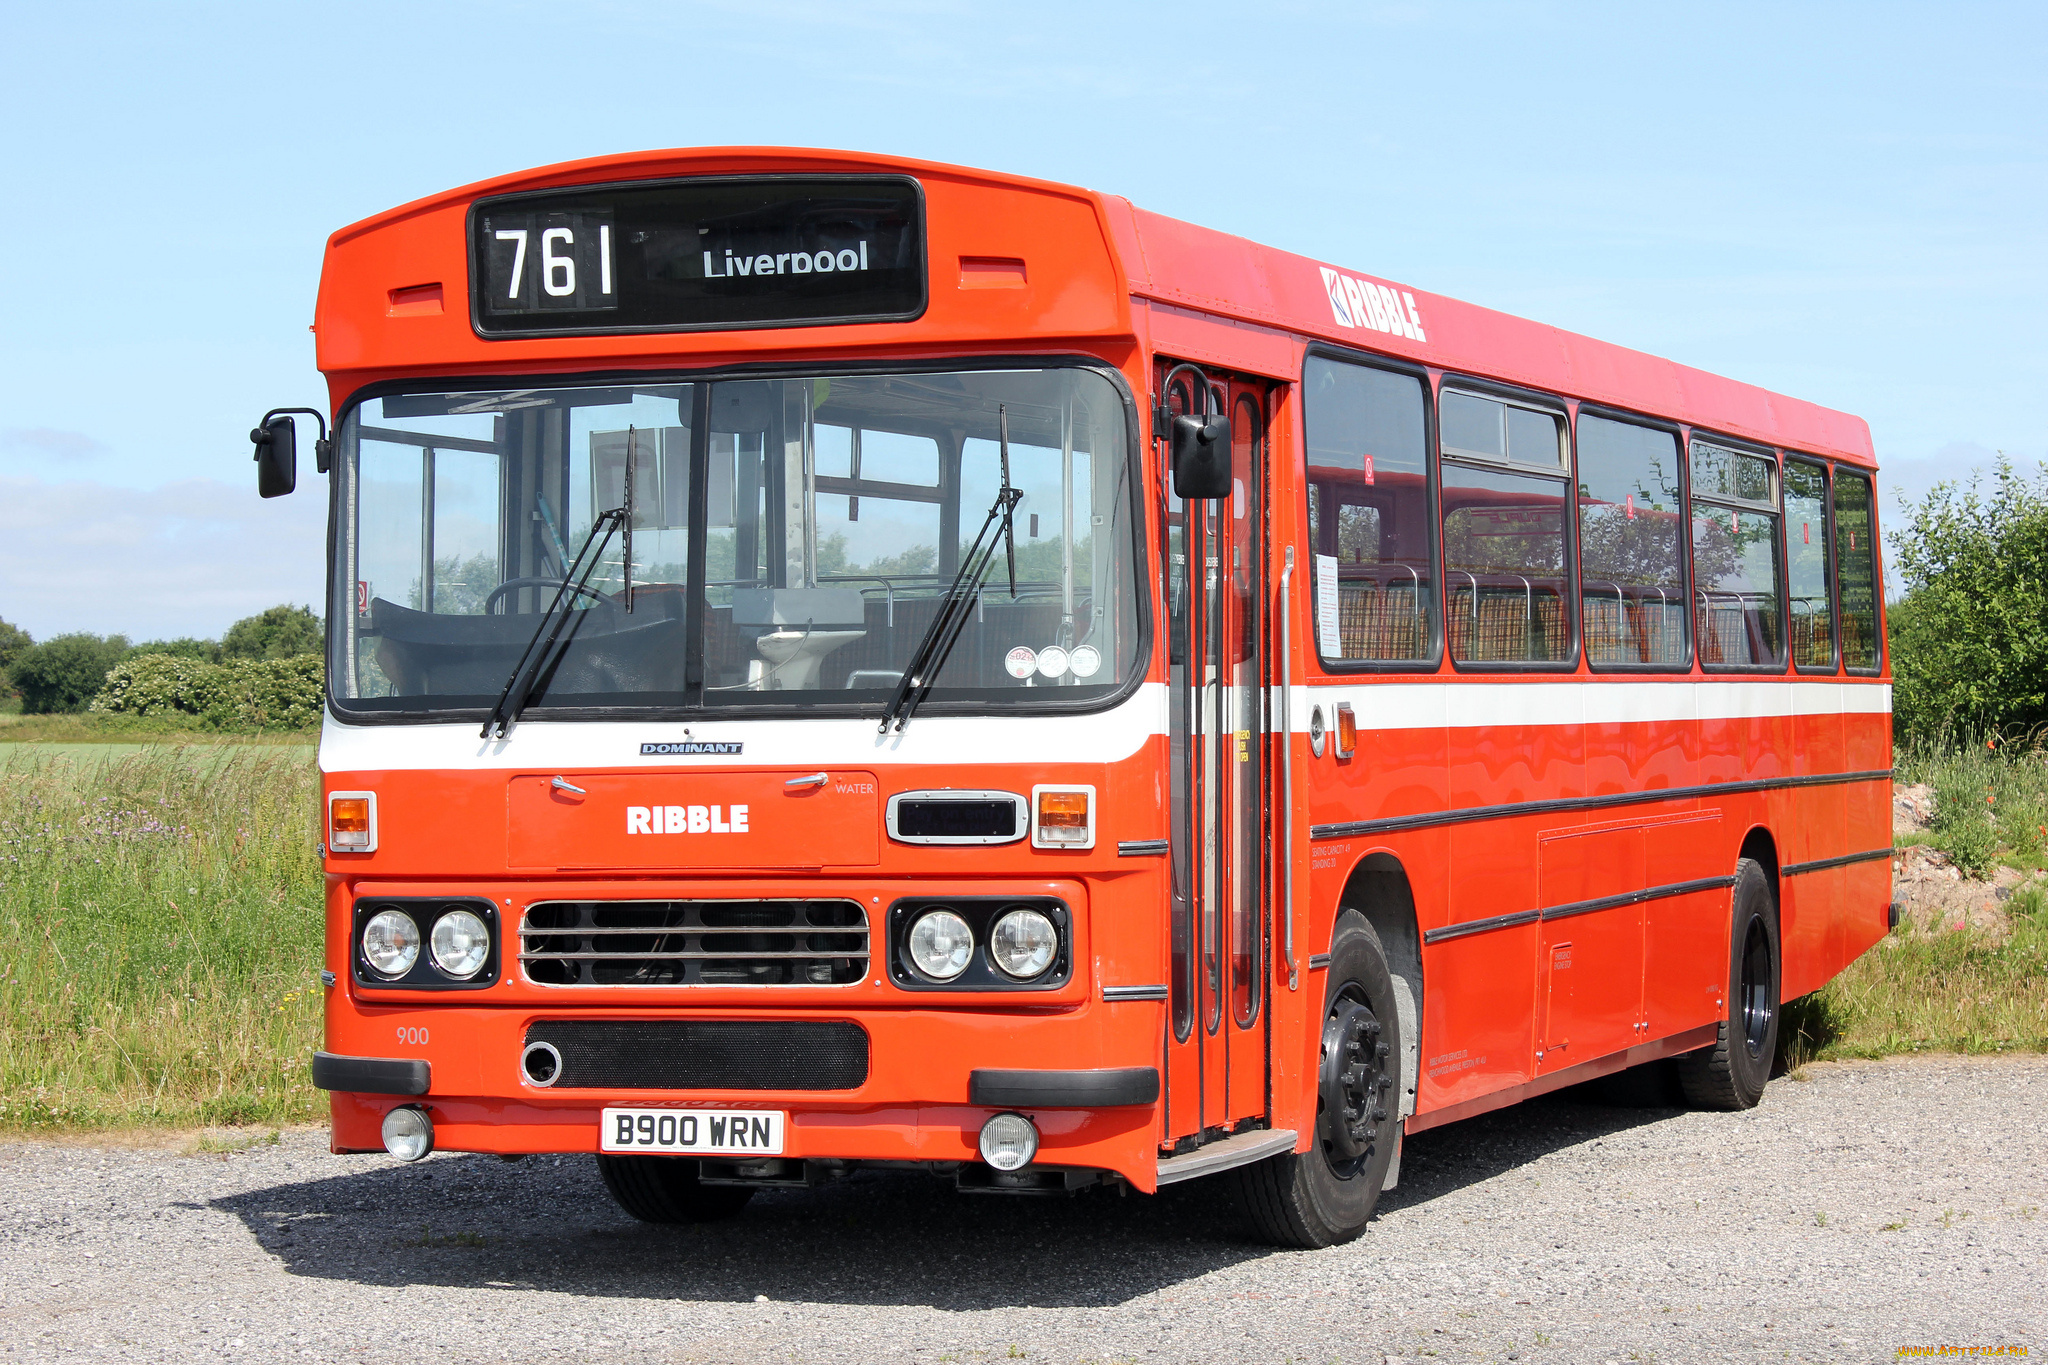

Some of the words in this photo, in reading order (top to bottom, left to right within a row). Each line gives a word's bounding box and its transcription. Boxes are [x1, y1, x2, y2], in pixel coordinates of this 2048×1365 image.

[495, 225, 612, 299] 761
[703, 240, 868, 279] Liverpool
[1340, 274, 1427, 343] RIBBLE
[642, 743, 742, 753] DOMINANT
[835, 783, 874, 794] WATER
[627, 804, 749, 835] RIBBLE
[940, 810, 959, 819] on
[964, 806, 1005, 822] entry
[396, 1026, 430, 1046] 900
[615, 1114, 698, 1146] B900
[708, 1116, 771, 1148] WRN
